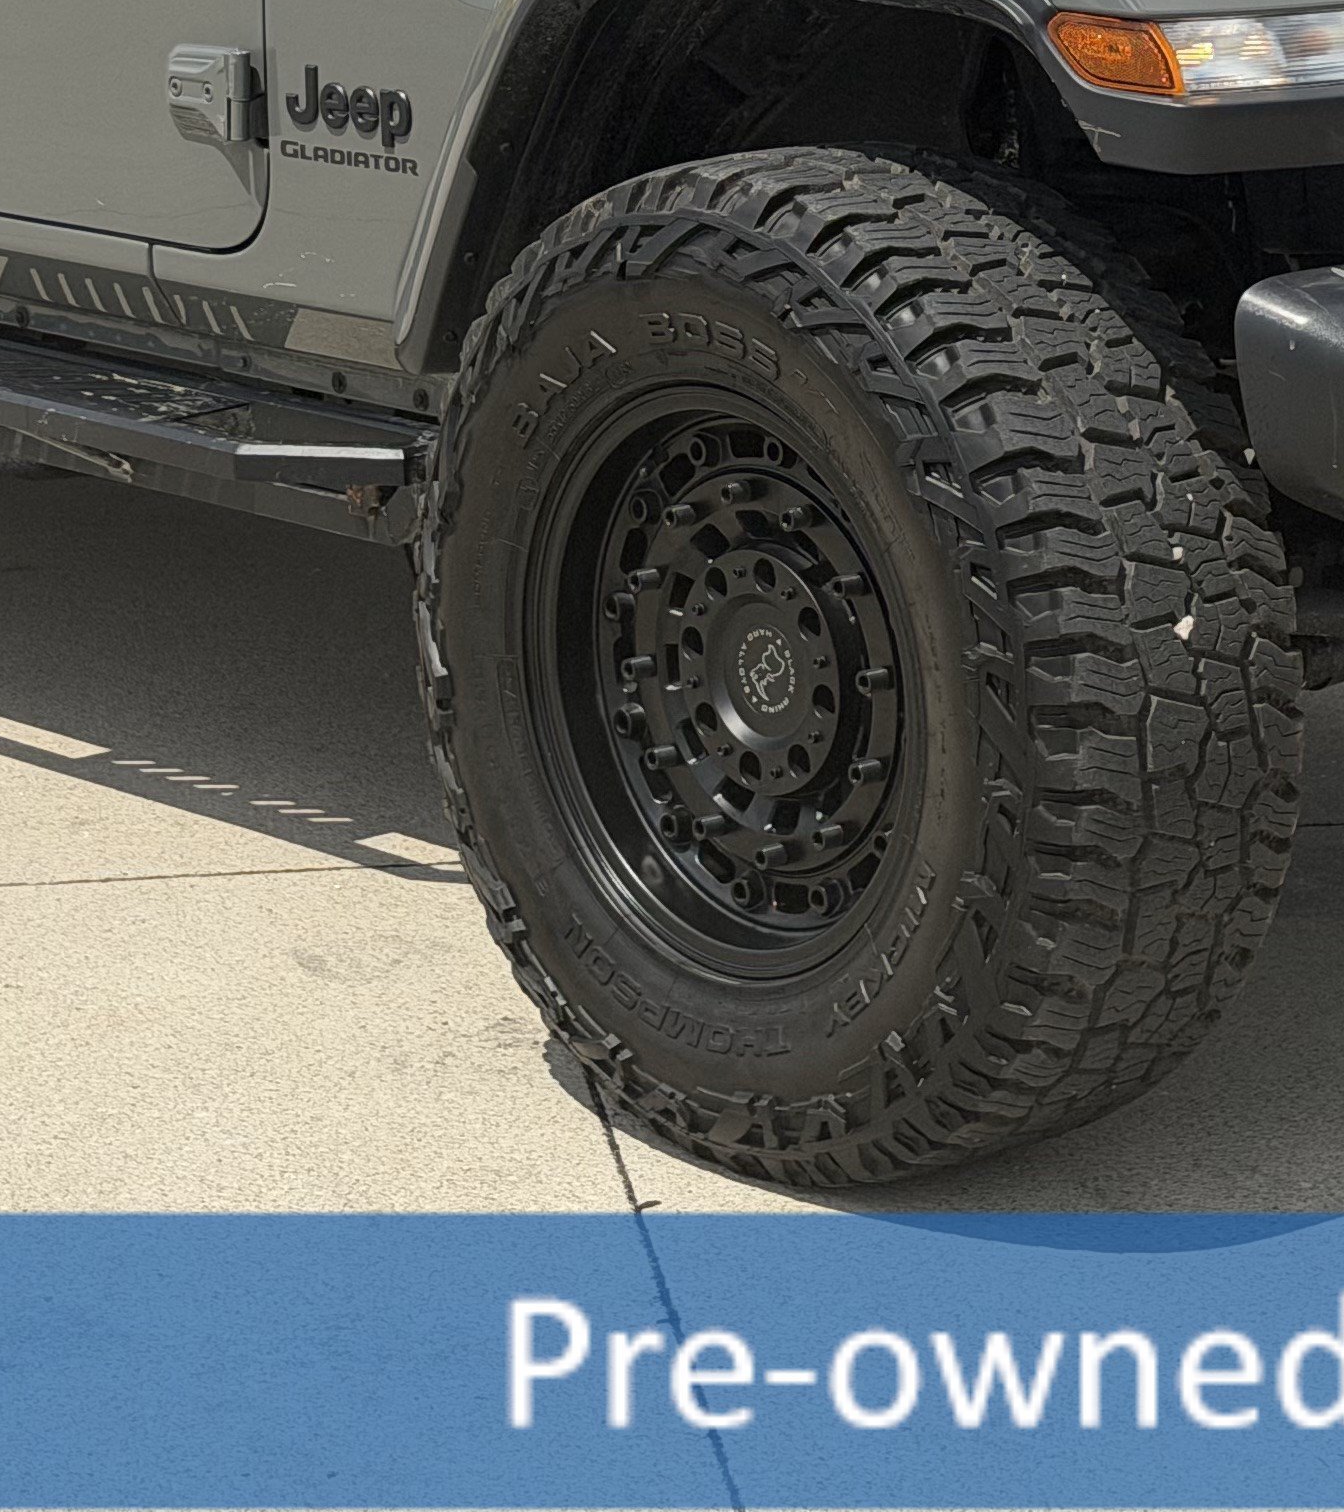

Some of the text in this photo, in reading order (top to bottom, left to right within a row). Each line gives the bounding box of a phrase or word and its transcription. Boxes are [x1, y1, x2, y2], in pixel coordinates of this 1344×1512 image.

[285, 64, 413, 147] Jeep
[280, 140, 419, 176] GLADIATOR
[562, 912, 793, 1059] THOMPSON
